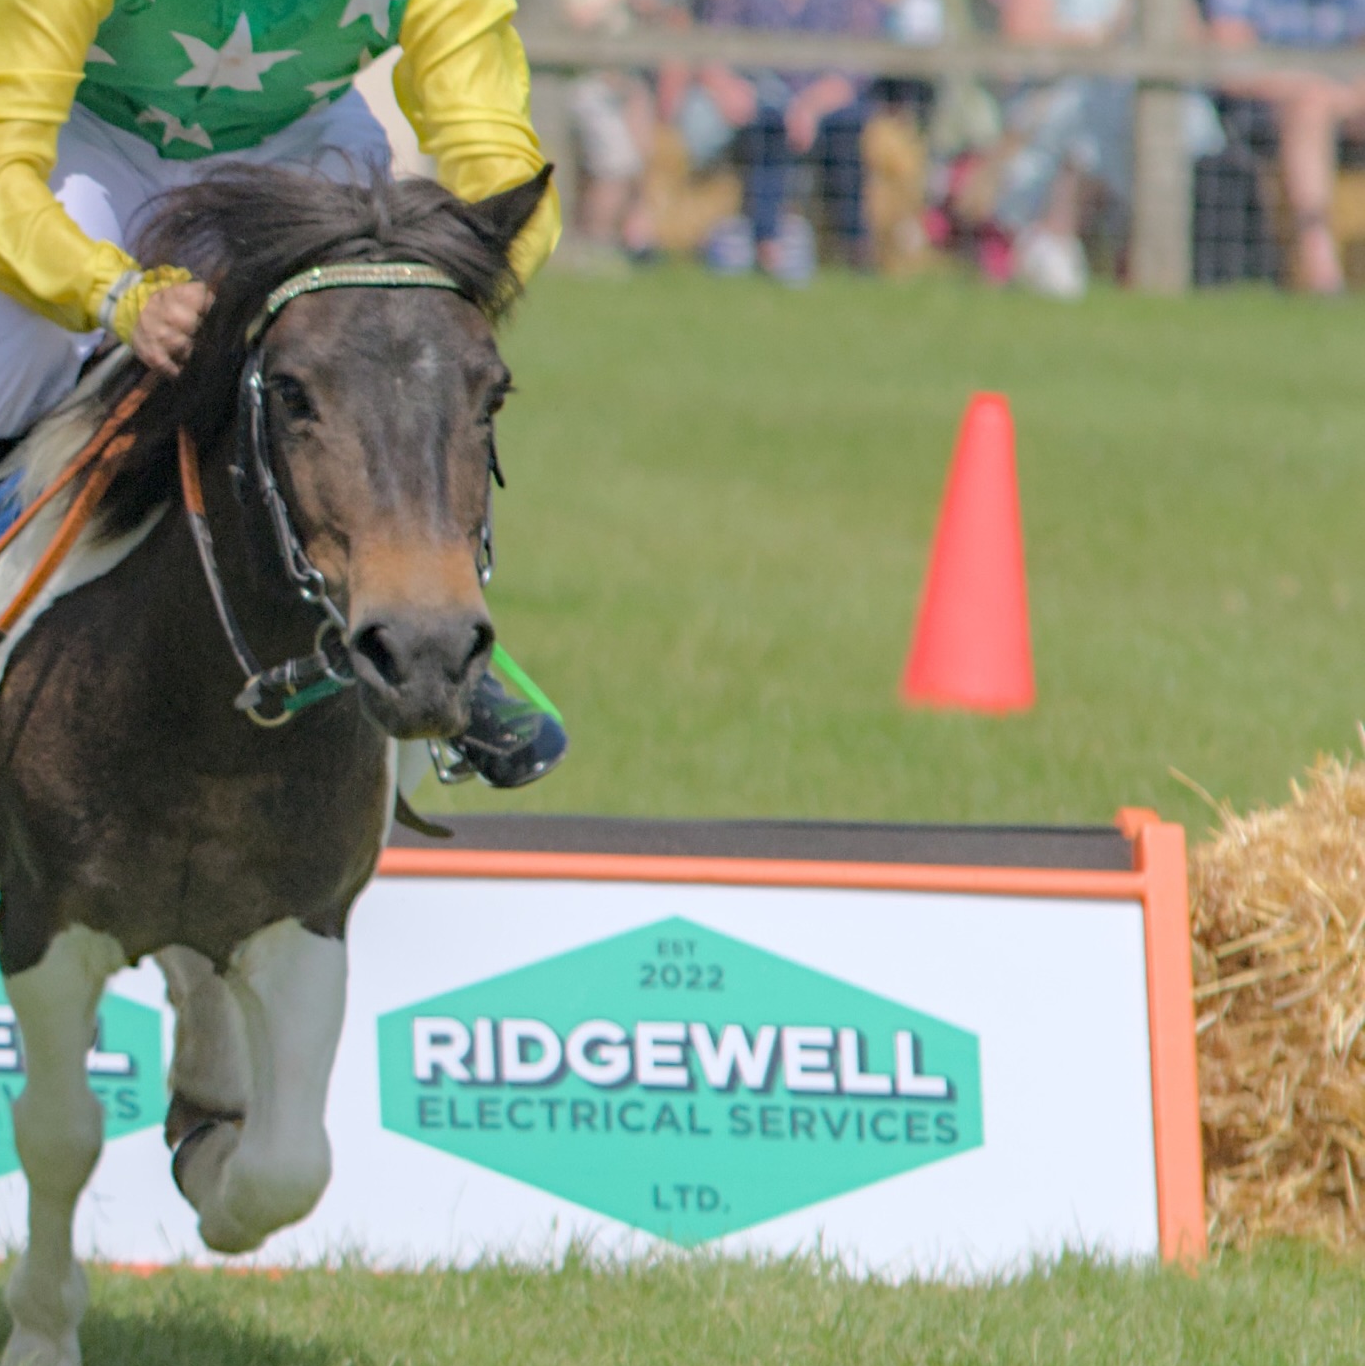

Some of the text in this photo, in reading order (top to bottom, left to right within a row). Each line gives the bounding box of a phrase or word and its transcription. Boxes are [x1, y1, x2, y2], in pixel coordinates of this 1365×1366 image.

[657, 938, 697, 957] EST
[638, 962, 725, 990] 2022
[411, 1015, 956, 1102] RIDGEWELL
[416, 1095, 961, 1146] ELECTRICAL SERVICES
